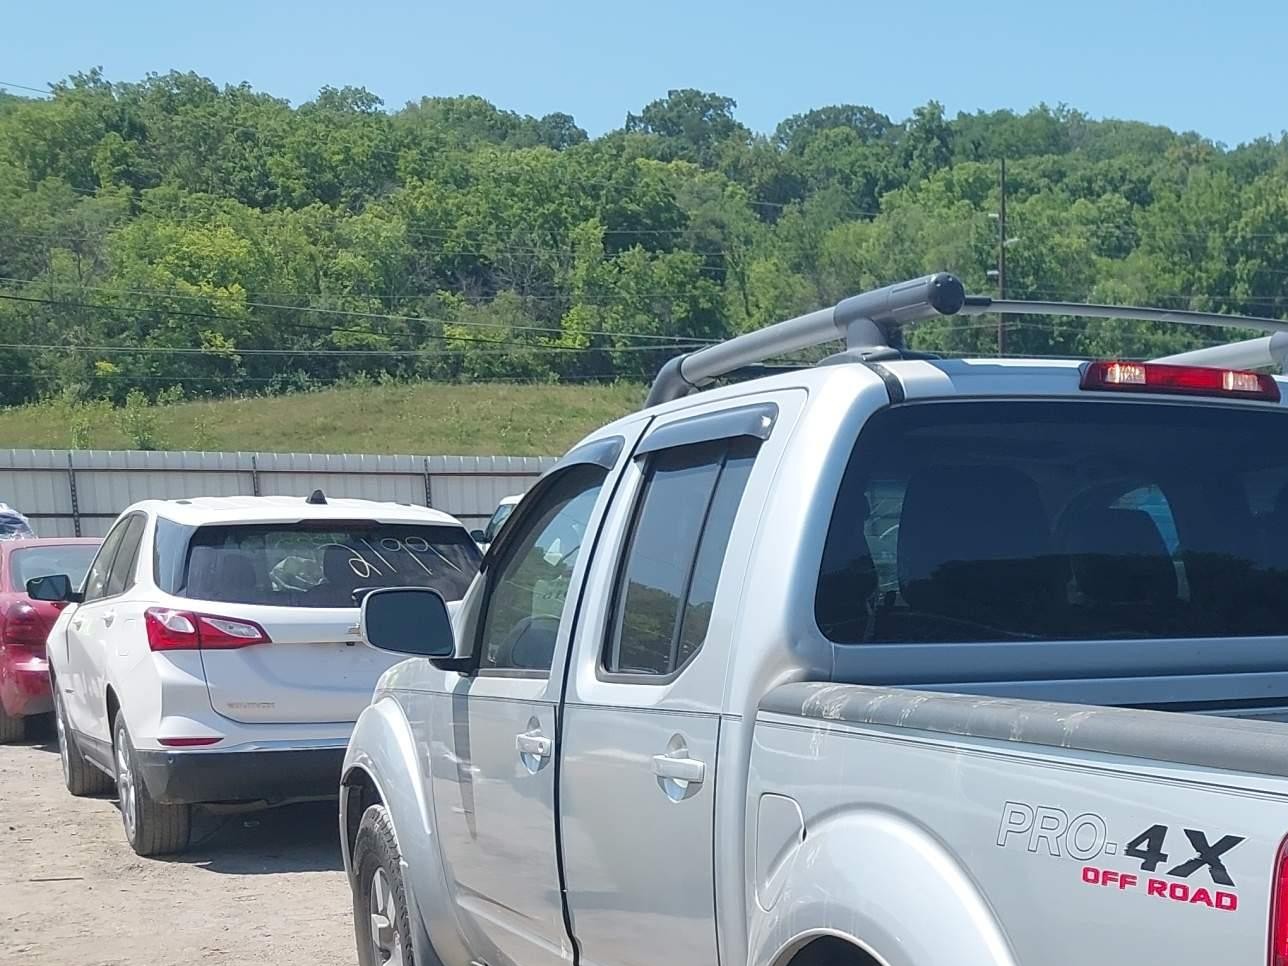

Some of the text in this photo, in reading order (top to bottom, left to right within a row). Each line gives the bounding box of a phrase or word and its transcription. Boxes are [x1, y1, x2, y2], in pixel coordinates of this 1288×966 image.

[318, 536, 464, 578] 2199
[996, 801, 1246, 887] PRO-4X
[1082, 867, 1238, 912] OFF ROAD
